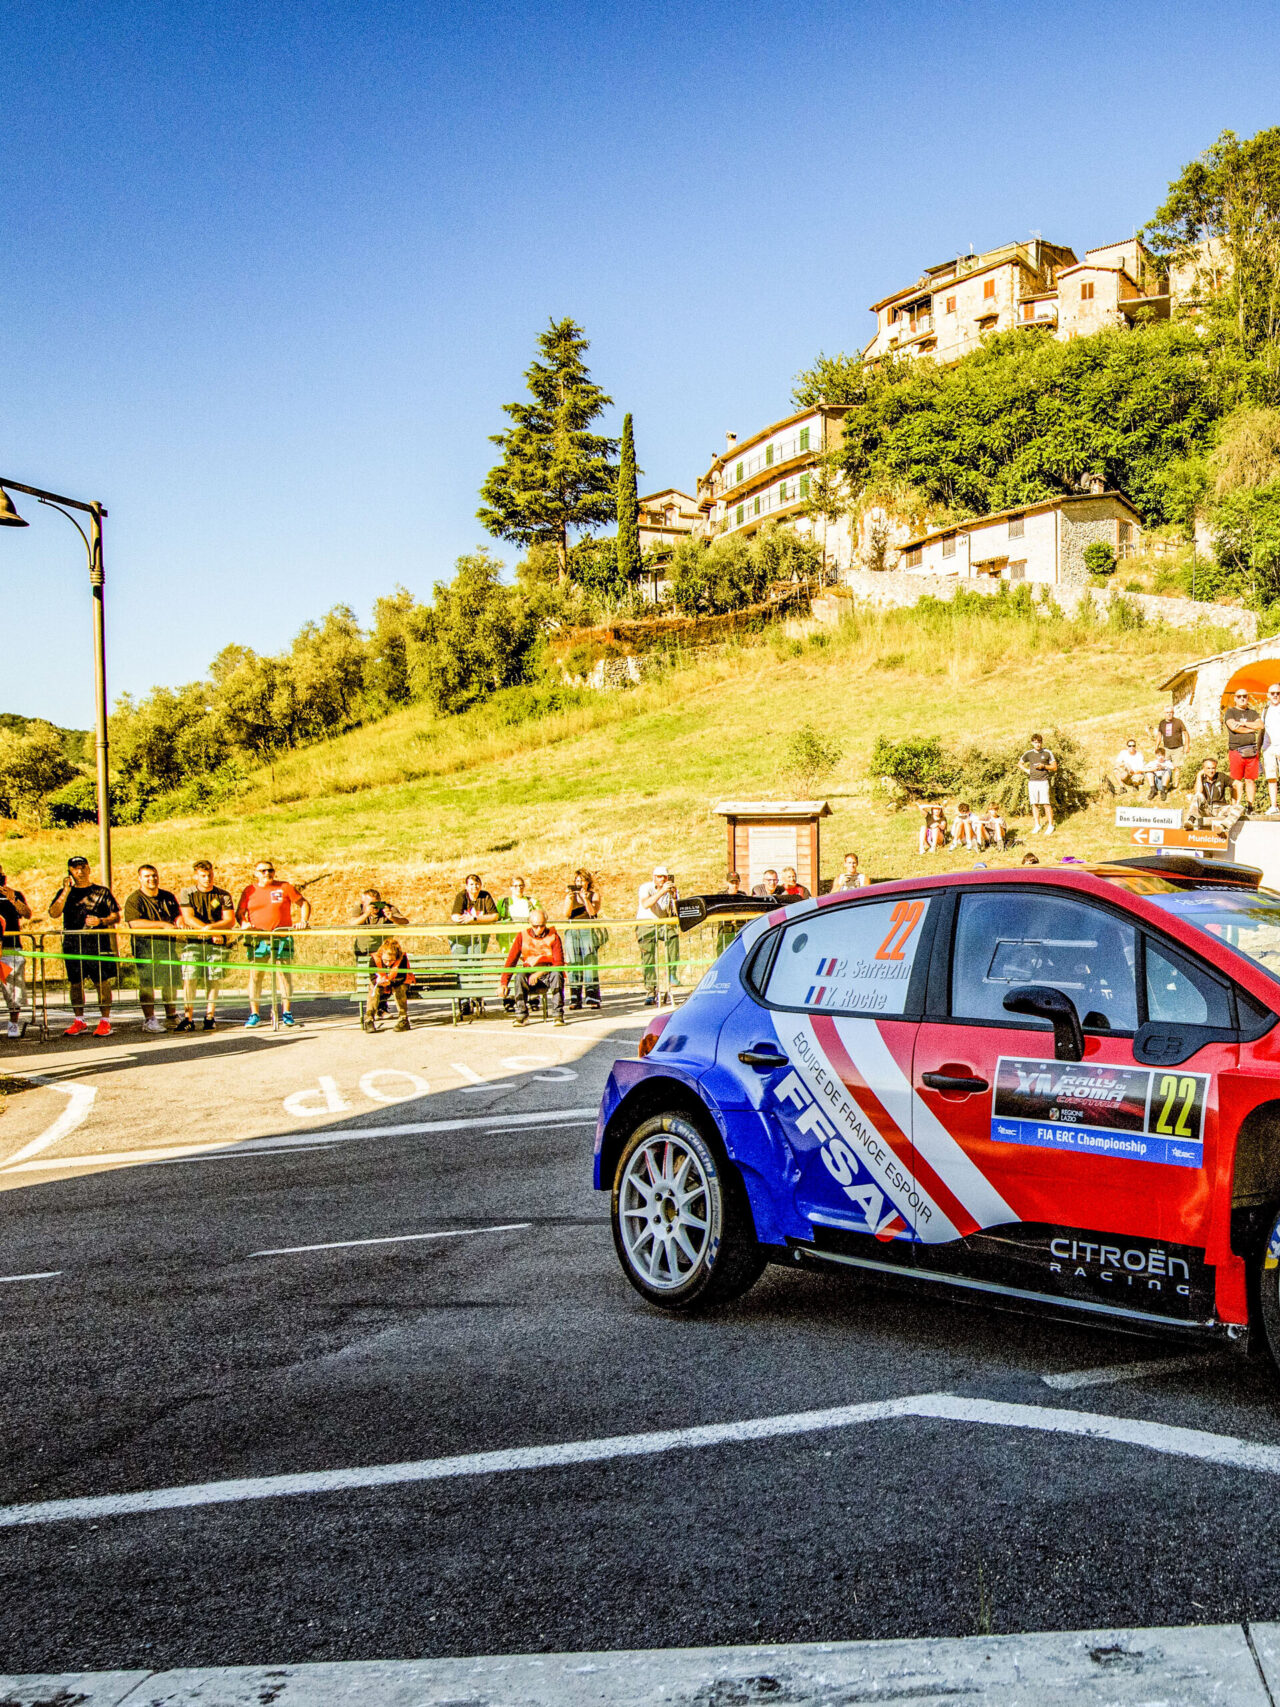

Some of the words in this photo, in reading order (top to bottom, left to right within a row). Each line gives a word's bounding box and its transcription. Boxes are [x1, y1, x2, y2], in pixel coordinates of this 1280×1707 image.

[1132, 815, 1152, 823] Sabino
[1152, 816, 1173, 825] Gentili
[874, 900, 925, 961] 22
[834, 959, 849, 979] P.
[851, 959, 912, 980] Sarrazin
[824, 986, 839, 1007] Y.
[840, 988, 888, 1010] Roche
[282, 1055, 580, 1118] STOP
[1058, 1086, 1127, 1102] ROMA
[1062, 1075, 1118, 1088] RALLY
[1060, 1109, 1084, 1118] REGIONE
[1156, 1075, 1197, 1138] 22
[792, 1031, 828, 1086] EQUIPE
[823, 1080, 842, 1107] DE
[838, 1102, 887, 1167] FRANCE
[884, 1162, 933, 1224] ESPOIR
[773, 1069, 886, 1233] FFSA
[1037, 1128, 1053, 1141] FIA
[1056, 1130, 1075, 1143] ERC
[1077, 1132, 1147, 1156] Championship
[1050, 1262, 1190, 1297] RACING
